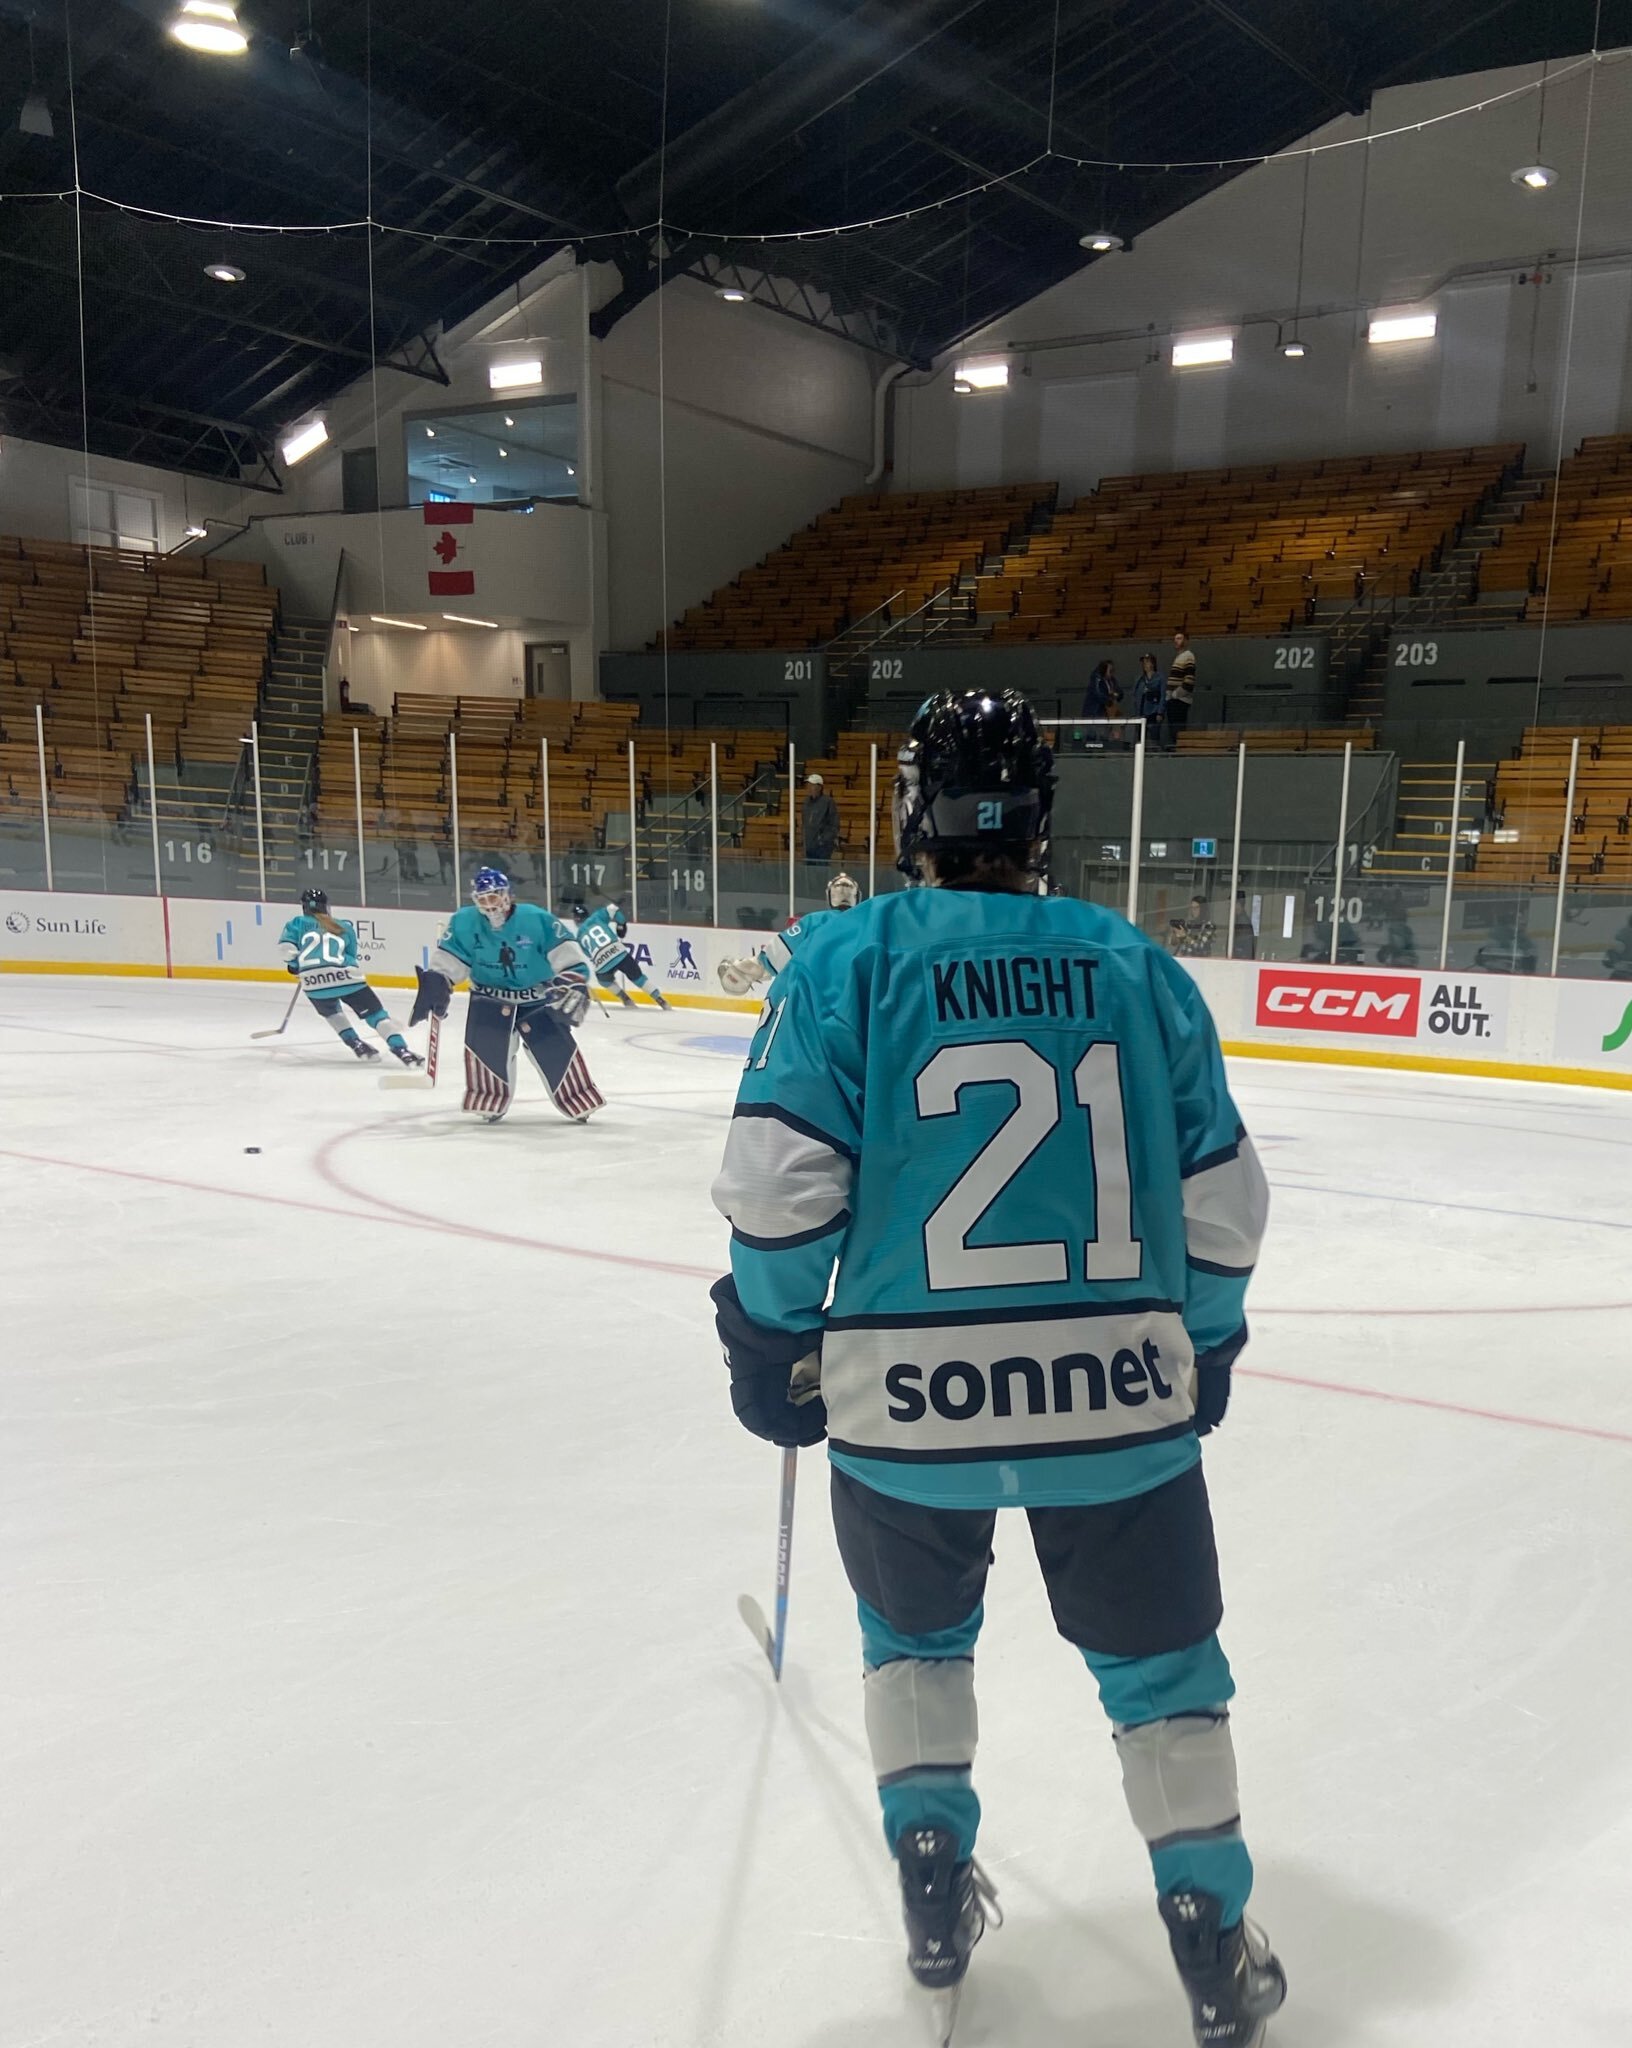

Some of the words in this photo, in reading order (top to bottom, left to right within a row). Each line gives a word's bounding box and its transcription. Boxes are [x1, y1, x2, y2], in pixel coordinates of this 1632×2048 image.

[1274, 647, 1315, 670] 202
[1395, 642, 1438, 667] 203
[785, 661, 812, 681] 201
[872, 659, 903, 679] 202
[1462, 785, 1471, 798] E
[977, 801, 1003, 829] 21
[1434, 822, 1443, 834] D
[165, 840, 212, 863] 116
[304, 849, 347, 871] 117
[571, 864, 605, 886] 117
[1421, 857, 1431, 871] C
[671, 869, 705, 892] 118
[1314, 896, 1363, 924] 120
[36, 917, 70, 933] Sun
[75, 919, 107, 935] Life
[347, 920, 386, 941] FL
[298, 930, 345, 967] 20
[581, 925, 612, 957] 28
[304, 969, 352, 986] sonnet
[667, 969, 701, 980] NHLPA
[933, 957, 1099, 1022] KNIGHT
[1430, 984, 1481, 1010] ALL
[1265, 986, 1411, 1020] CCM
[1428, 1011, 1491, 1038] OUT.
[913, 1039, 1142, 1293] 21
[885, 1337, 1173, 1423] sonnet
